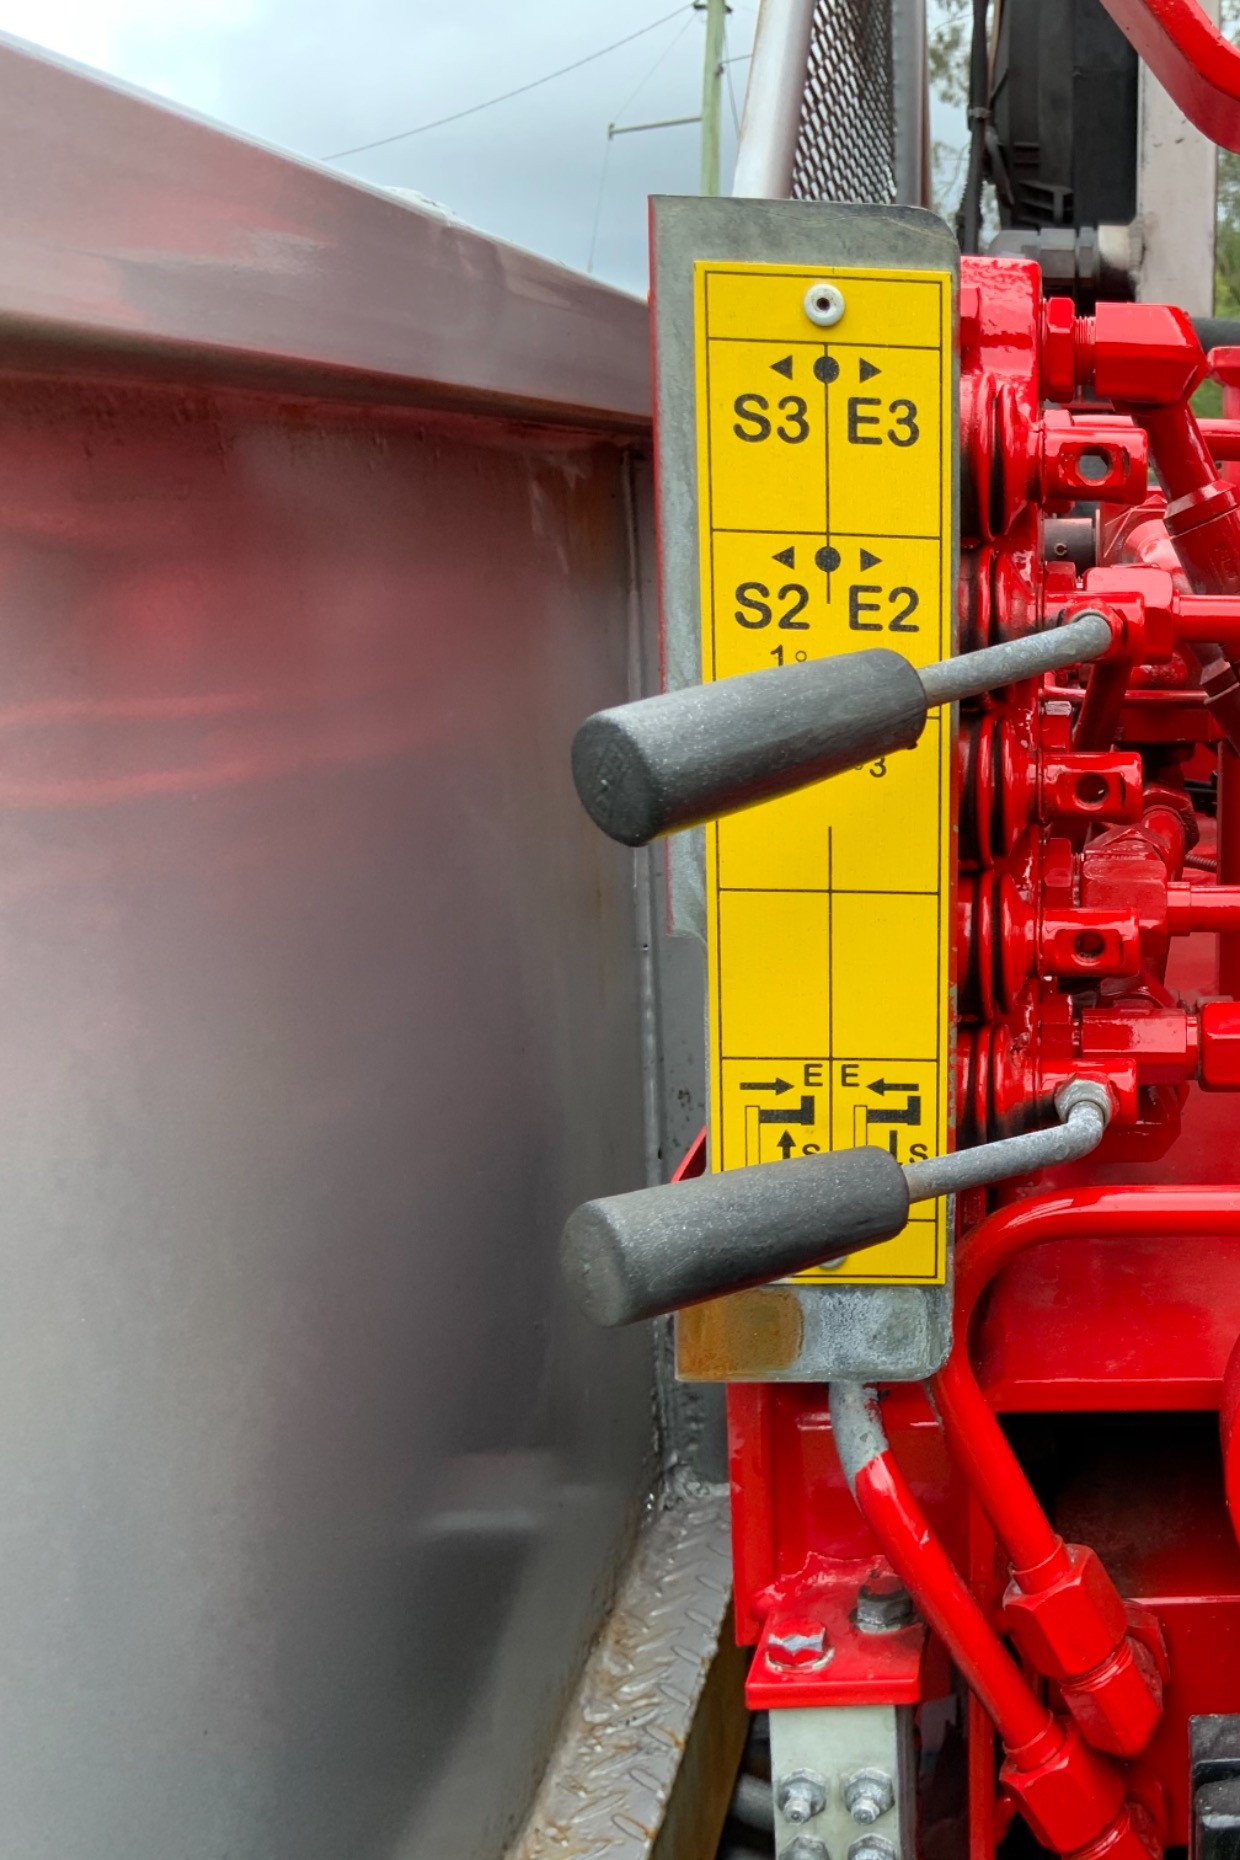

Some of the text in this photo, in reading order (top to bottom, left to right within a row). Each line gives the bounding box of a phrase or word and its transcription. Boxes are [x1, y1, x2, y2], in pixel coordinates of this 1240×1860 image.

[733, 393, 810, 444] S3
[847, 396, 920, 448] E3
[734, 581, 811, 630] S2
[848, 584, 920, 633] E2
[804, 1063, 823, 1087] E
[841, 1063, 860, 1087] E
